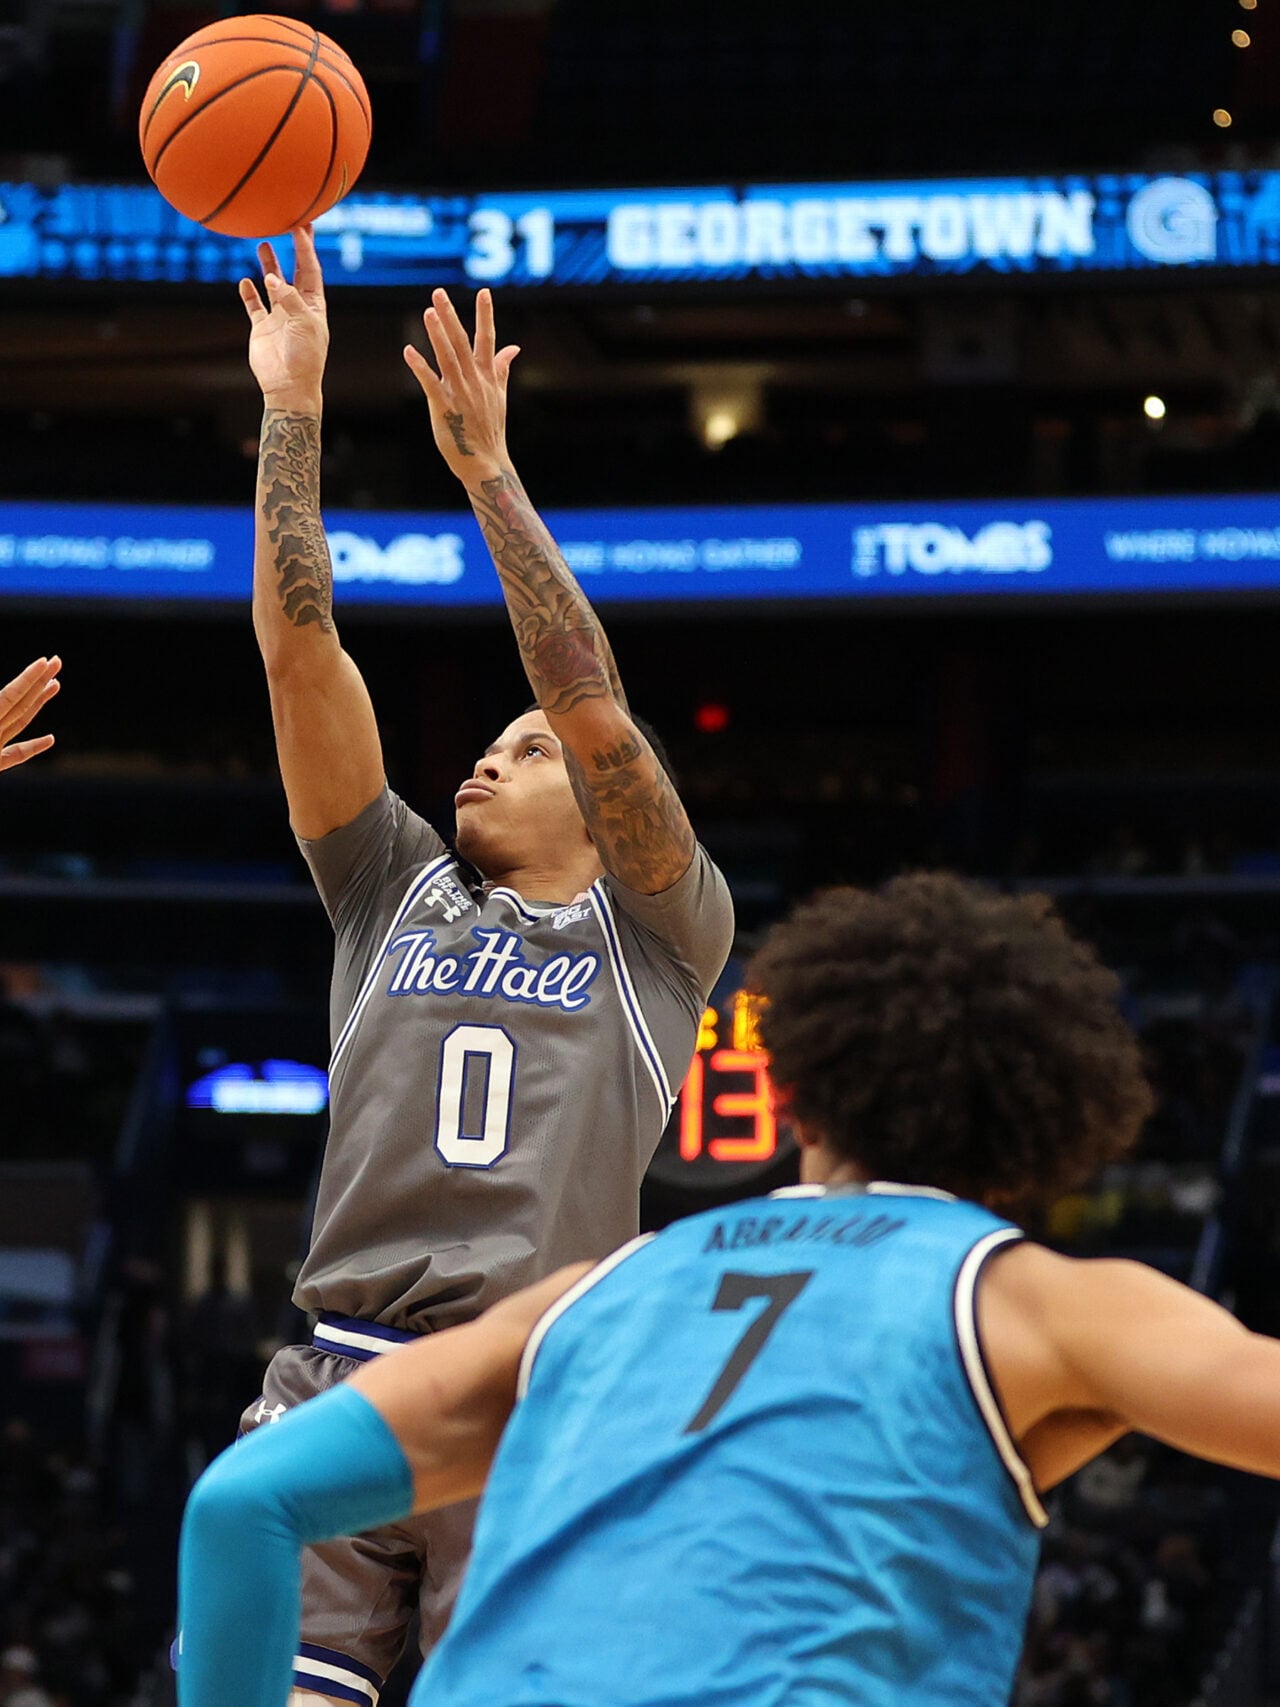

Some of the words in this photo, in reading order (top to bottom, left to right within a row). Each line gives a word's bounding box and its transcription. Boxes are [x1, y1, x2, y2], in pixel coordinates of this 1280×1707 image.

[465, 208, 554, 280] 31
[606, 190, 1095, 270] GEORGETOWN
[388, 928, 460, 995] The
[465, 927, 602, 1011] Hall
[434, 1022, 517, 1169] 0
[680, 1050, 777, 1161] 13
[681, 1270, 815, 1435] 7
